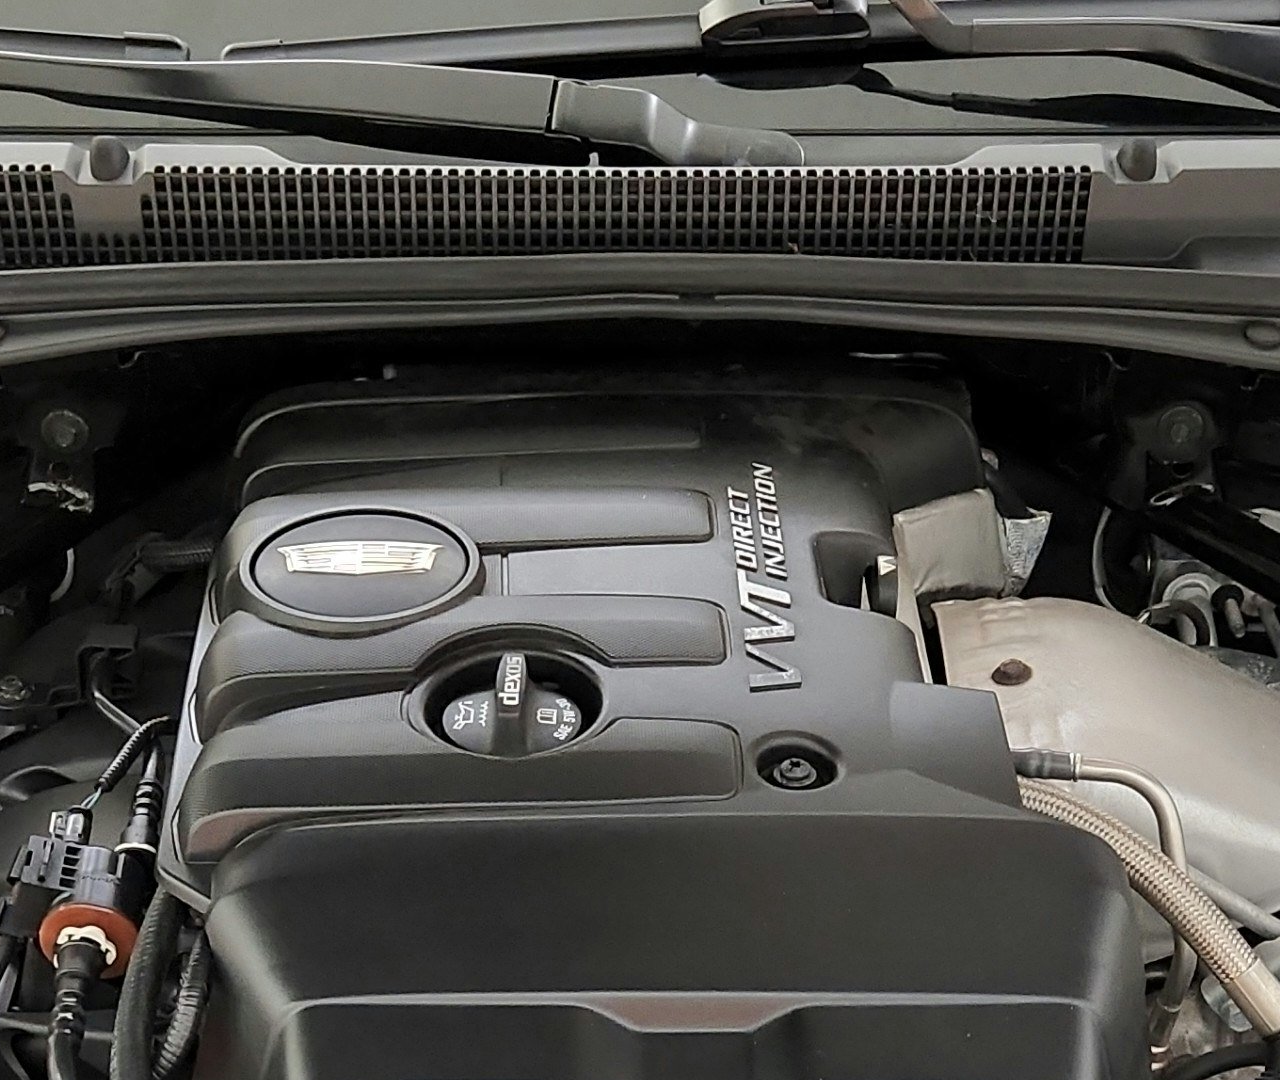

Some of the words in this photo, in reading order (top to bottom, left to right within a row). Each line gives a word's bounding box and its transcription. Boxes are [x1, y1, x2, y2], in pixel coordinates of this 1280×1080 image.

[727, 486, 757, 570] DIRECT
[752, 462, 788, 578] INJECTION
[737, 569, 802, 691] VVT
[498, 656, 523, 706] dexos
[553, 724, 573, 741] SAE
